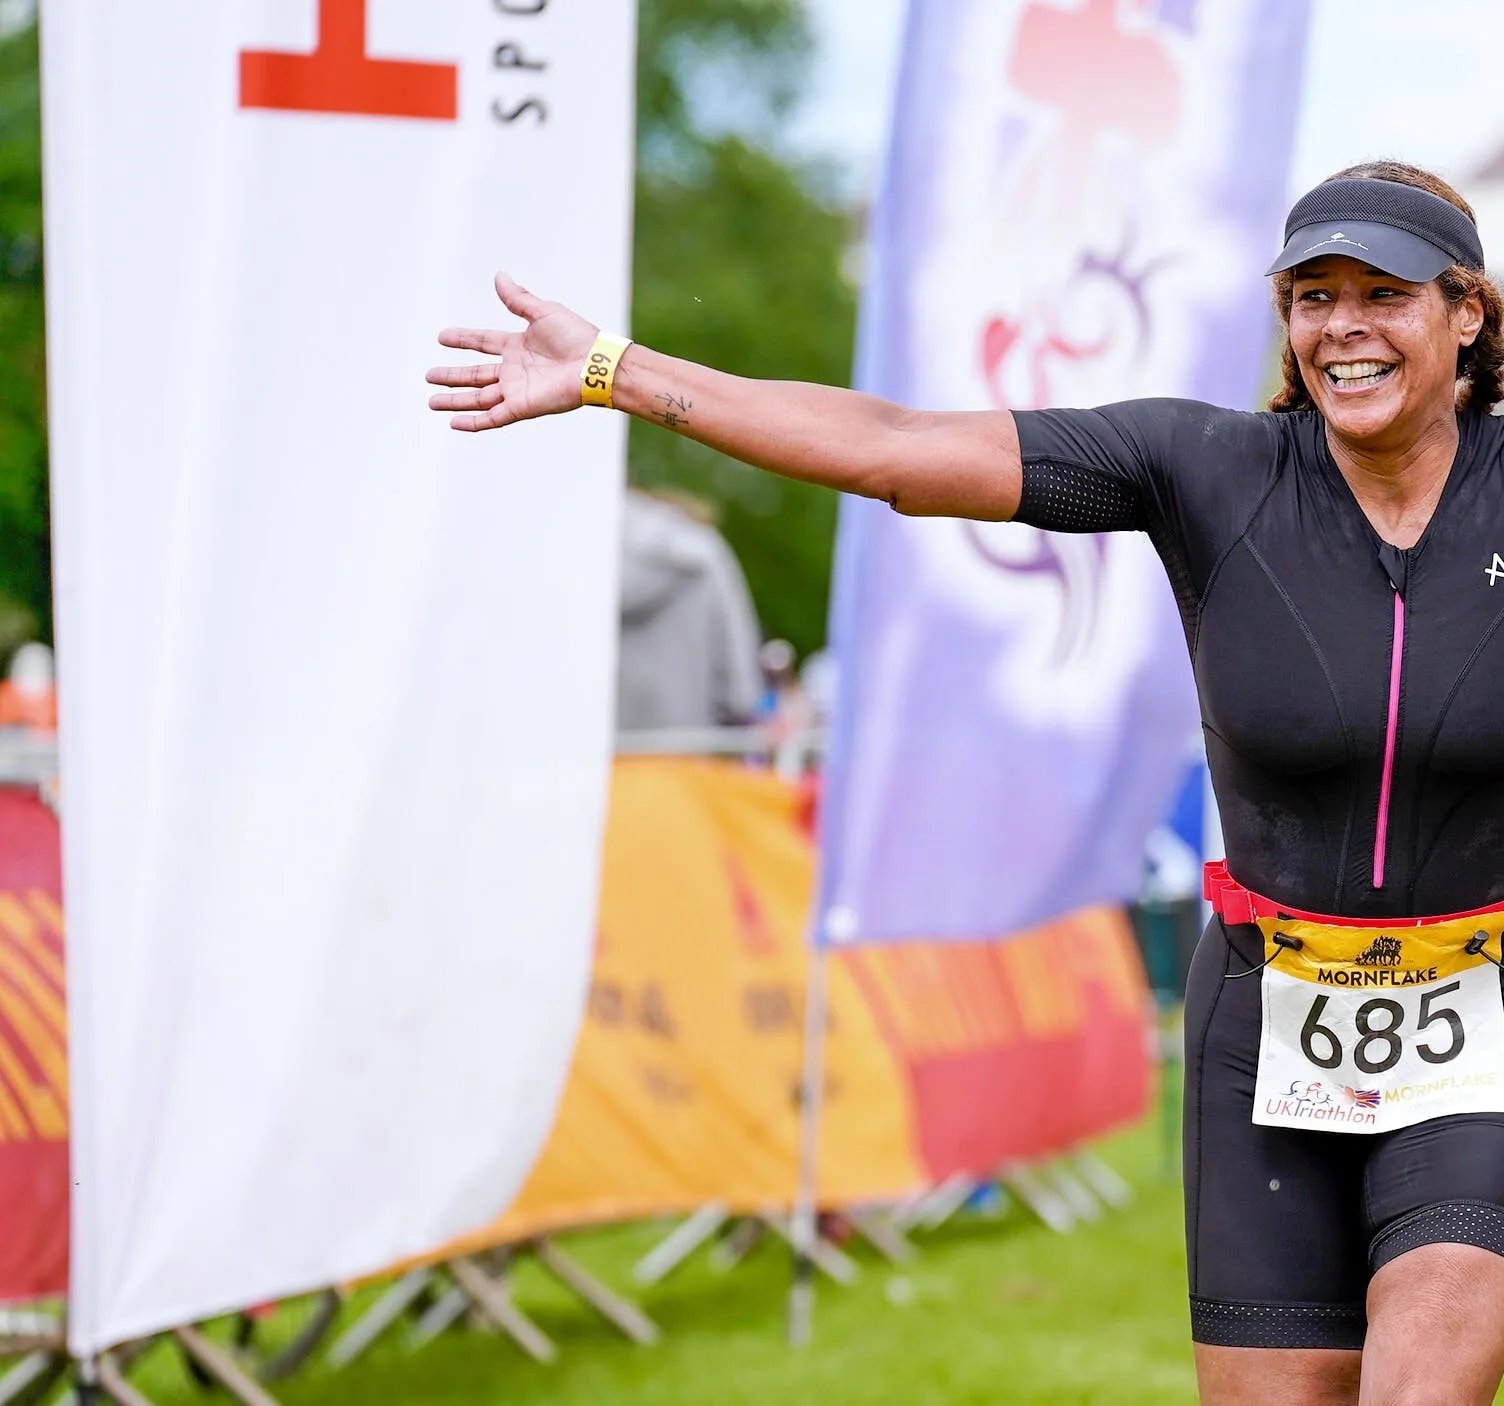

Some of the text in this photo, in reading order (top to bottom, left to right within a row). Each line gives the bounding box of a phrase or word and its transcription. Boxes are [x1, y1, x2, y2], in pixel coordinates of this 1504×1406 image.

[584, 352, 612, 391] 685
[1317, 966, 1438, 986] MORNFLAKE
[1300, 981, 1465, 1074] 685
